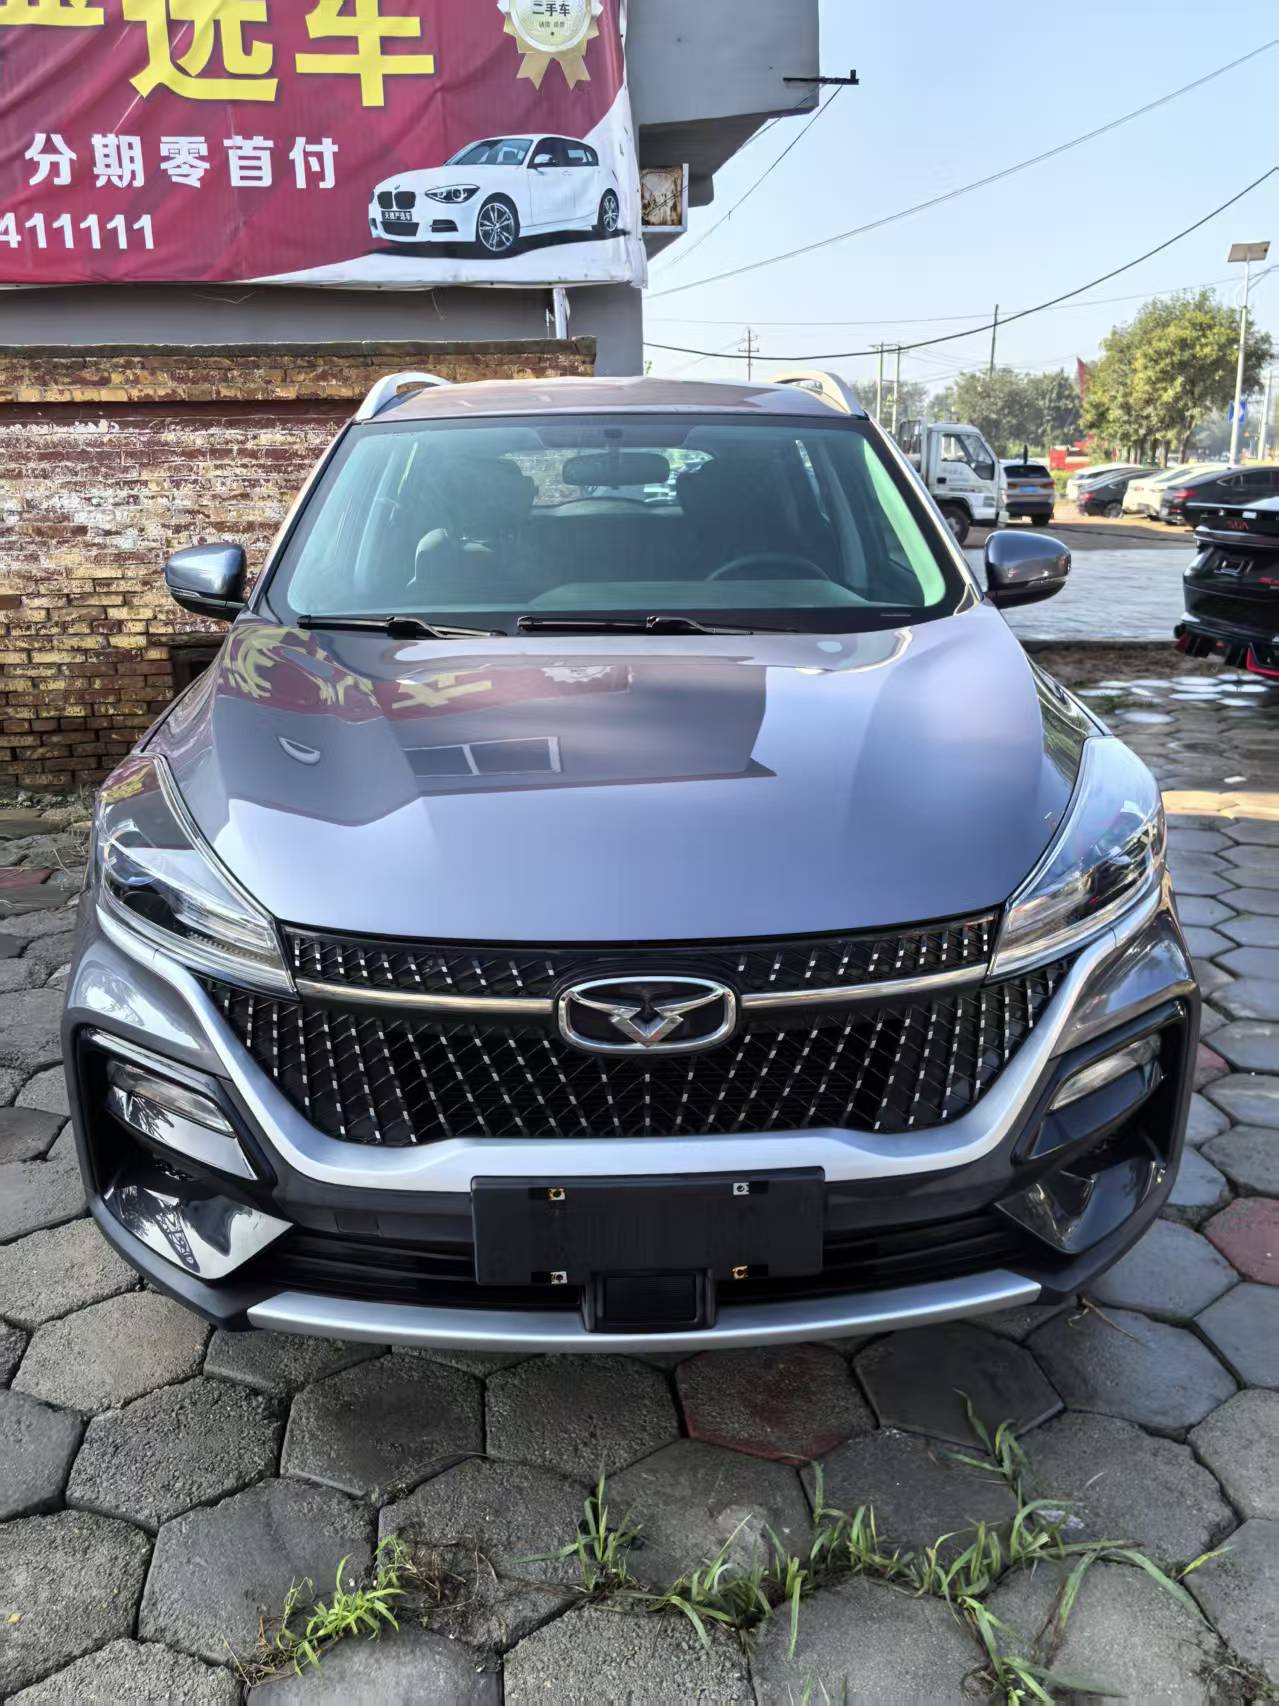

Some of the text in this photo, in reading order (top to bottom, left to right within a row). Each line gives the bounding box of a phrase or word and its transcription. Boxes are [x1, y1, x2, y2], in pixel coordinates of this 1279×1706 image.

[532, 3, 571, 17] 二手车
[0, 0, 435, 107] 选车
[24, 132, 340, 189] 分期零首付
[0, 212, 154, 249] 411111
